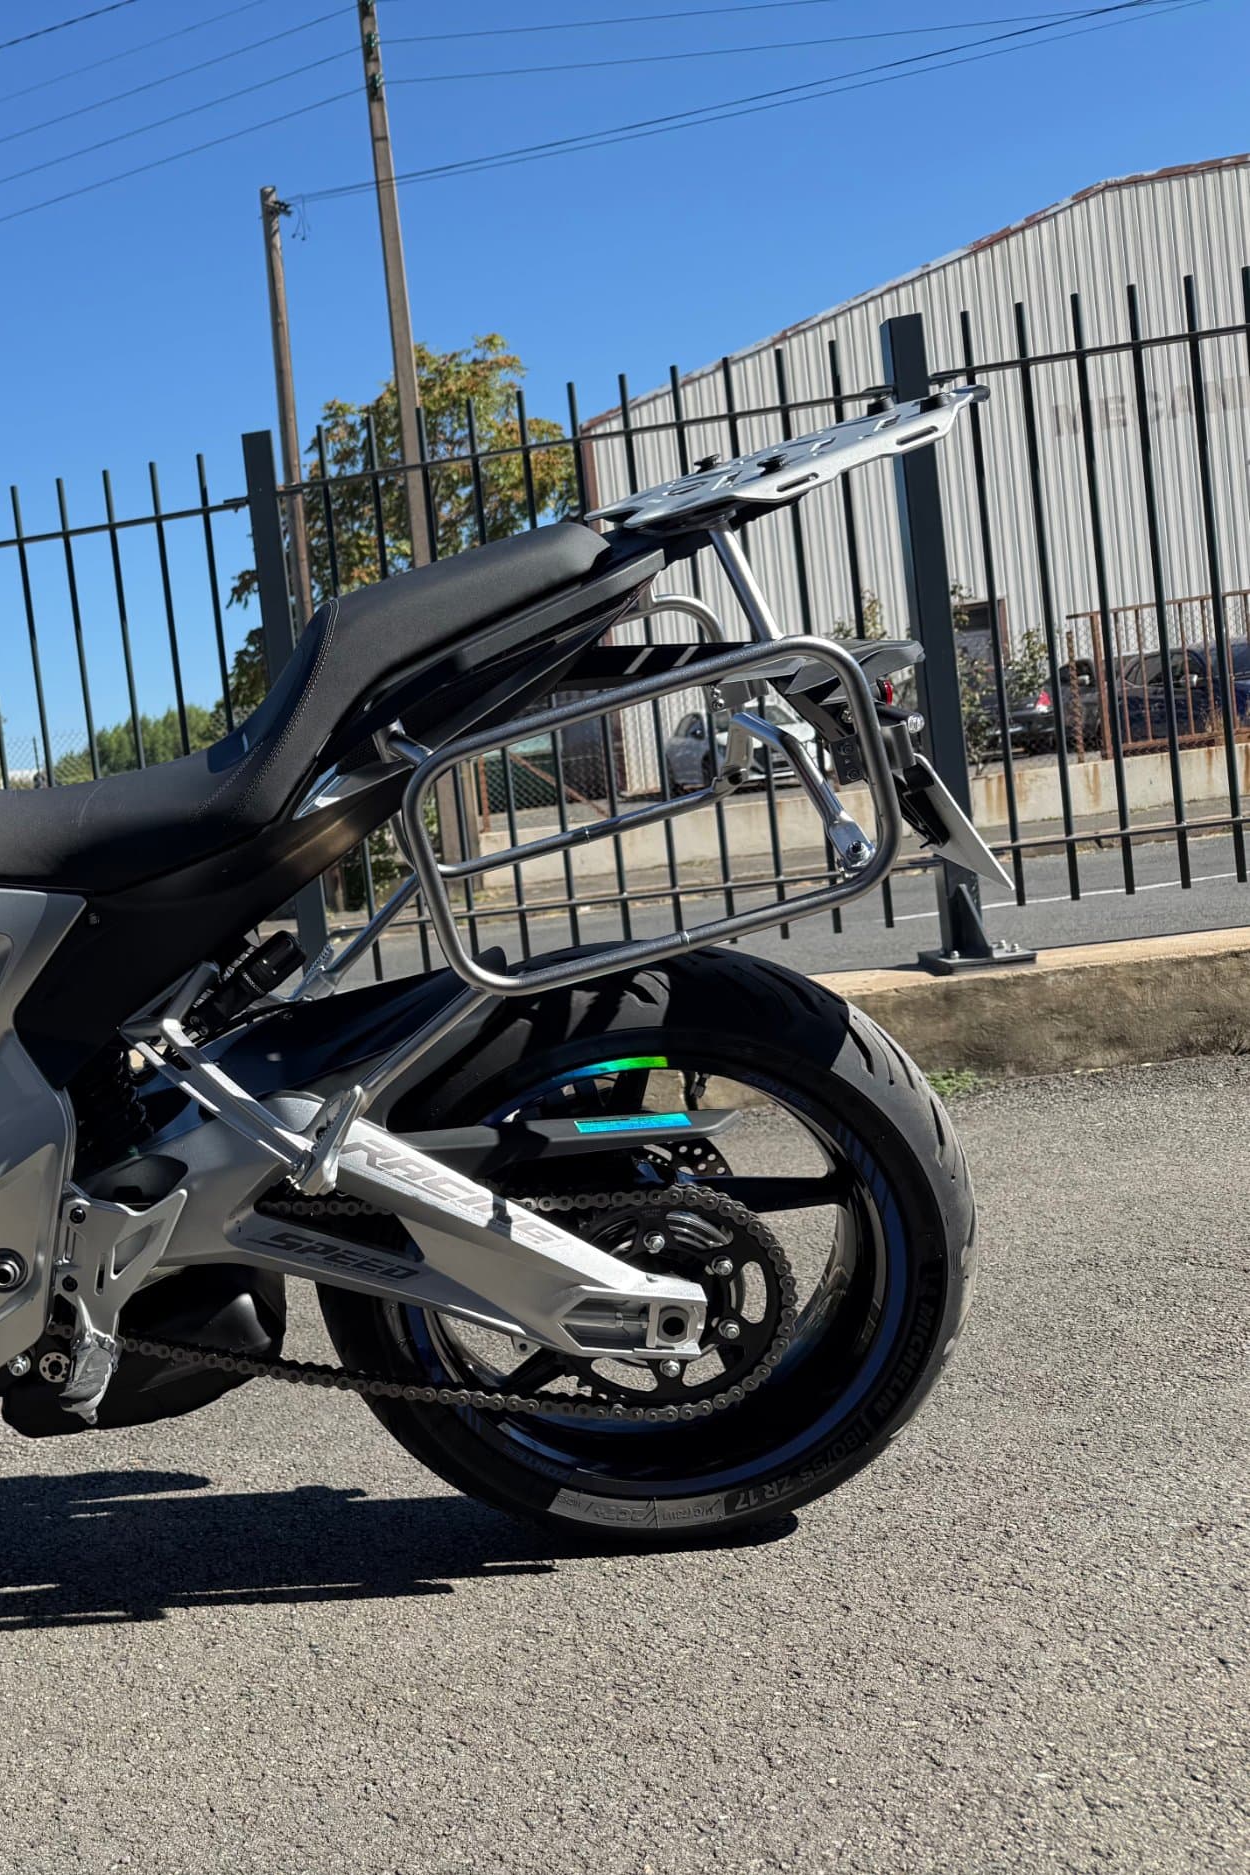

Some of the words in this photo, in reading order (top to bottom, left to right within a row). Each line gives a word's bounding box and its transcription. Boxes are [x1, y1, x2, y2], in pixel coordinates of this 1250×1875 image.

[339, 1139, 565, 1244] RACING
[260, 1232, 420, 1280] SPEED
[873, 1299, 937, 1417] MICHELIN
[734, 1484, 760, 1512] 17
[764, 1475, 797, 1500] ZR
